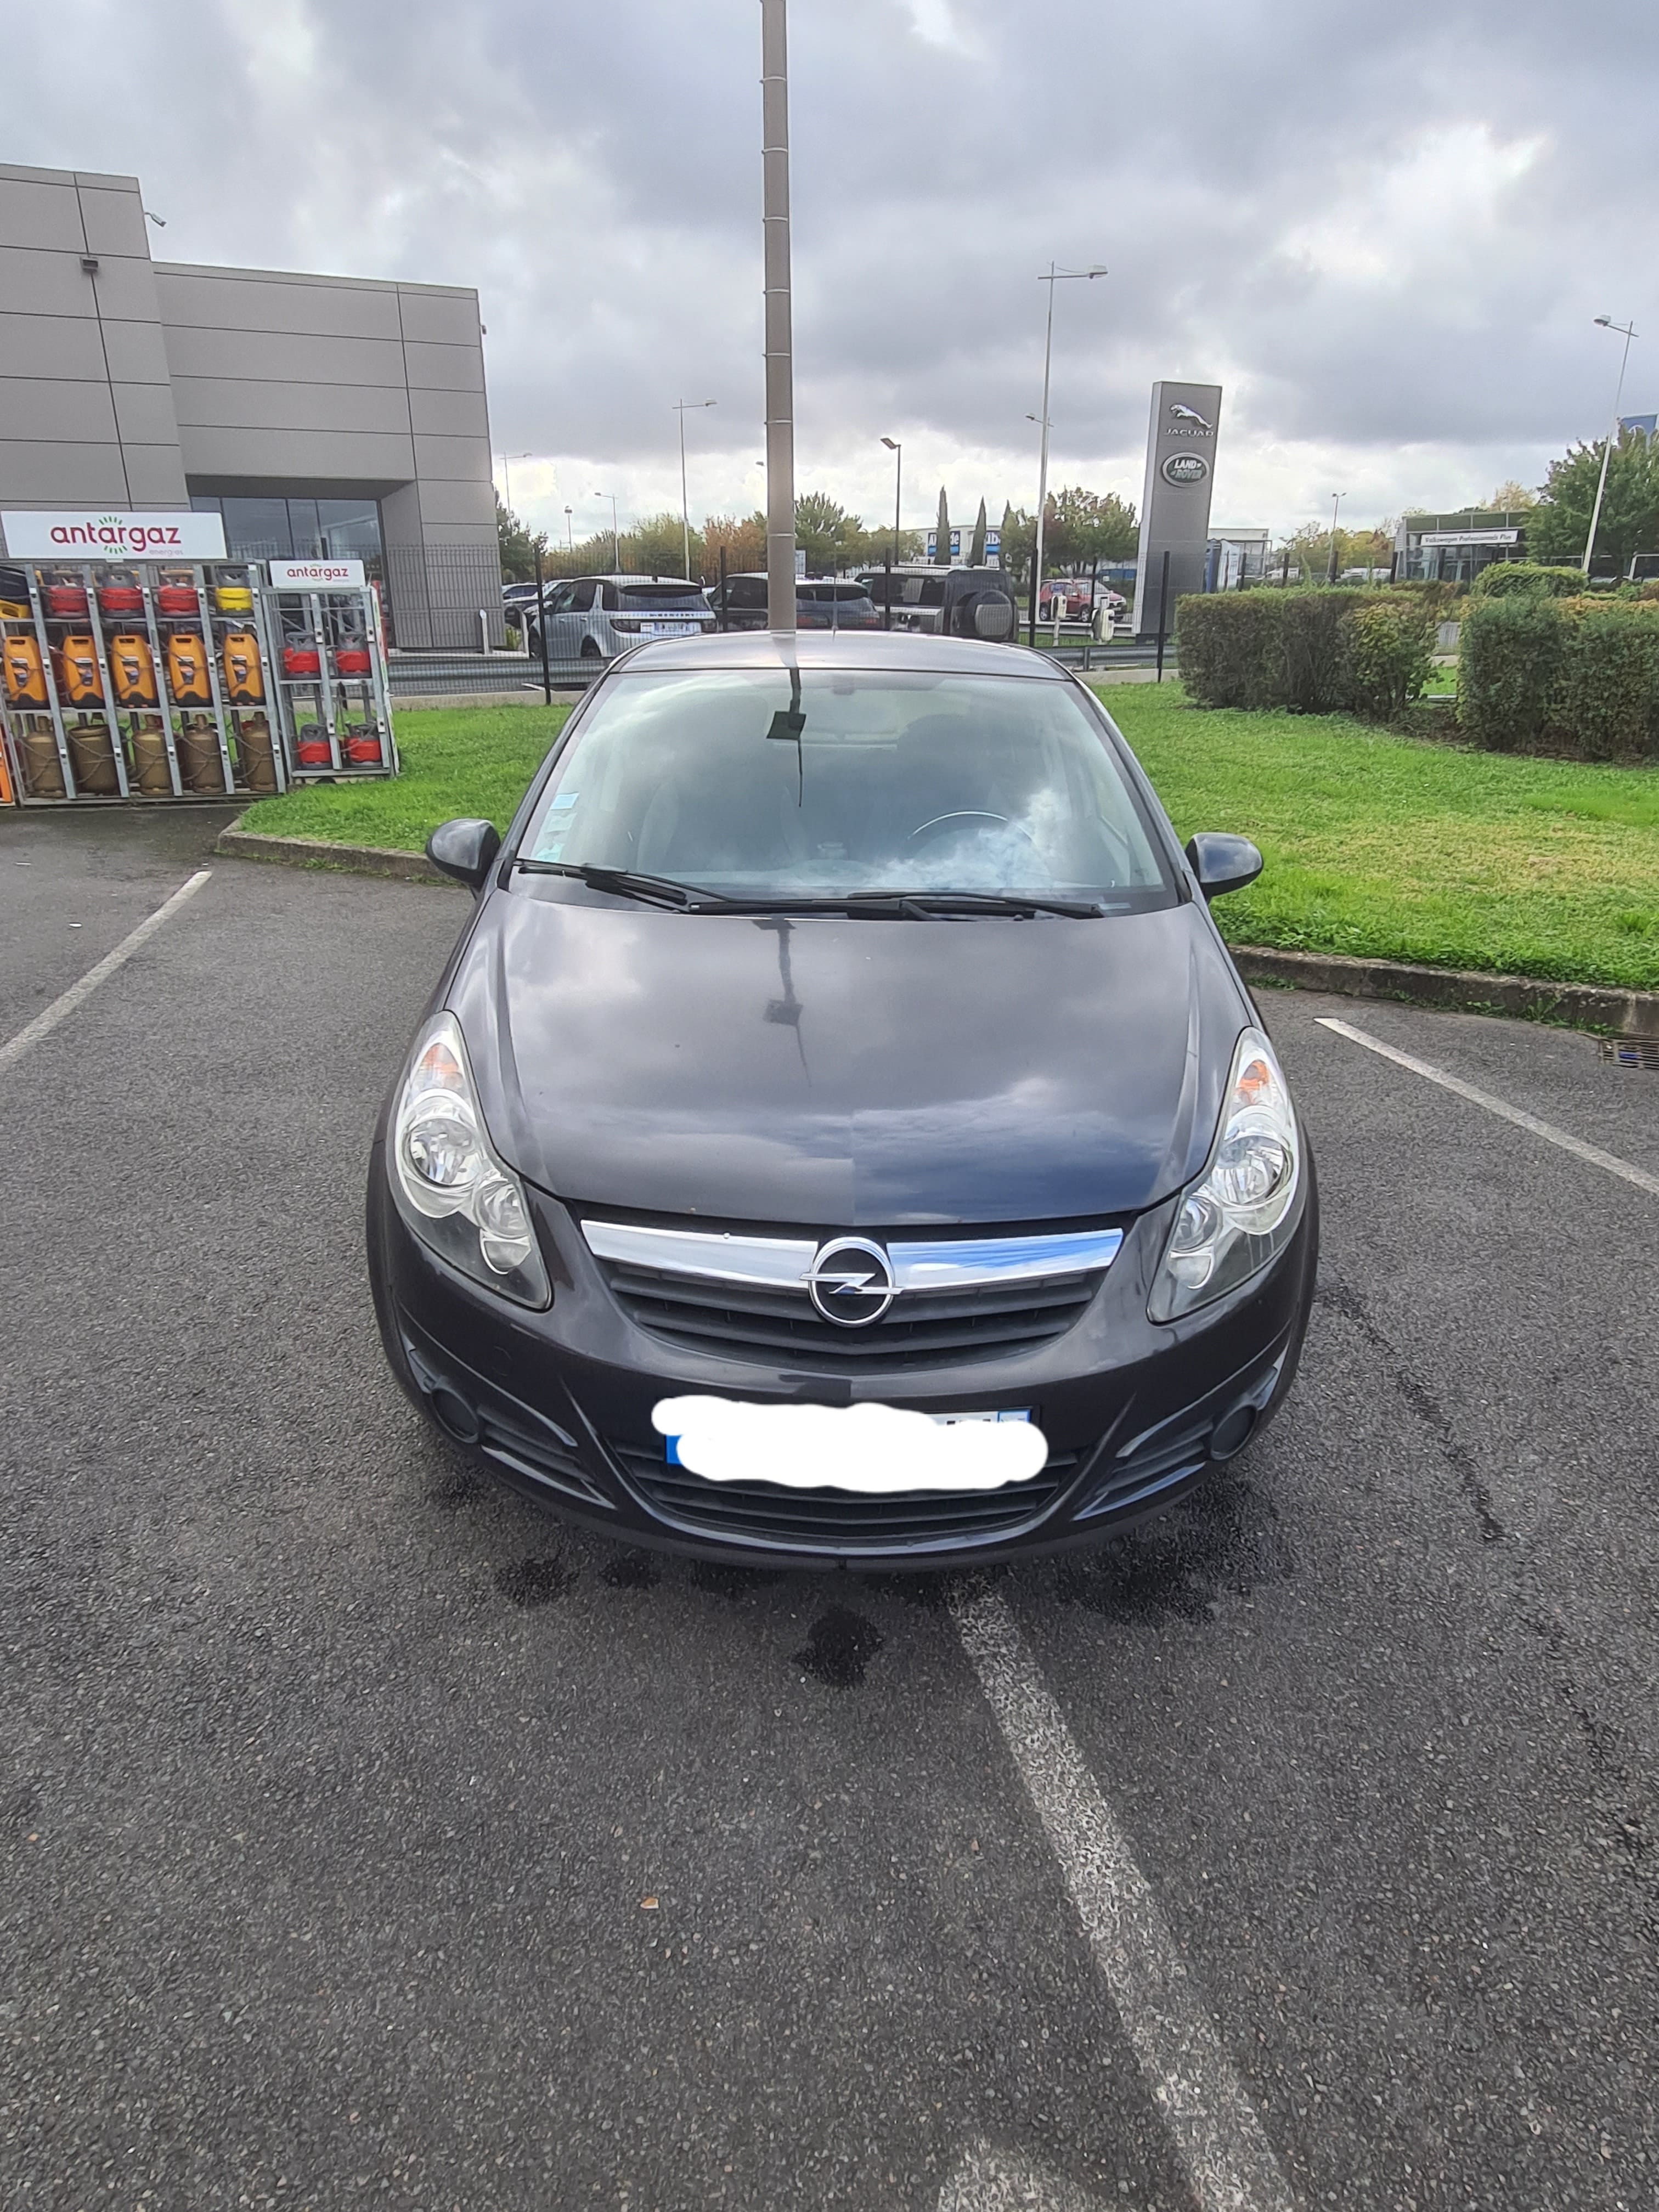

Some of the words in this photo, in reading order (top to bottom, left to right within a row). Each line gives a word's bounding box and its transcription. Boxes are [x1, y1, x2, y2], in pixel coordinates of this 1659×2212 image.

[1164, 428, 1214, 437] JAGUAR
[1174, 459, 1197, 469] LAND
[1175, 469, 1203, 479] ROVER
[50, 522, 182, 552] antargaz
[287, 567, 349, 581] antargaz
